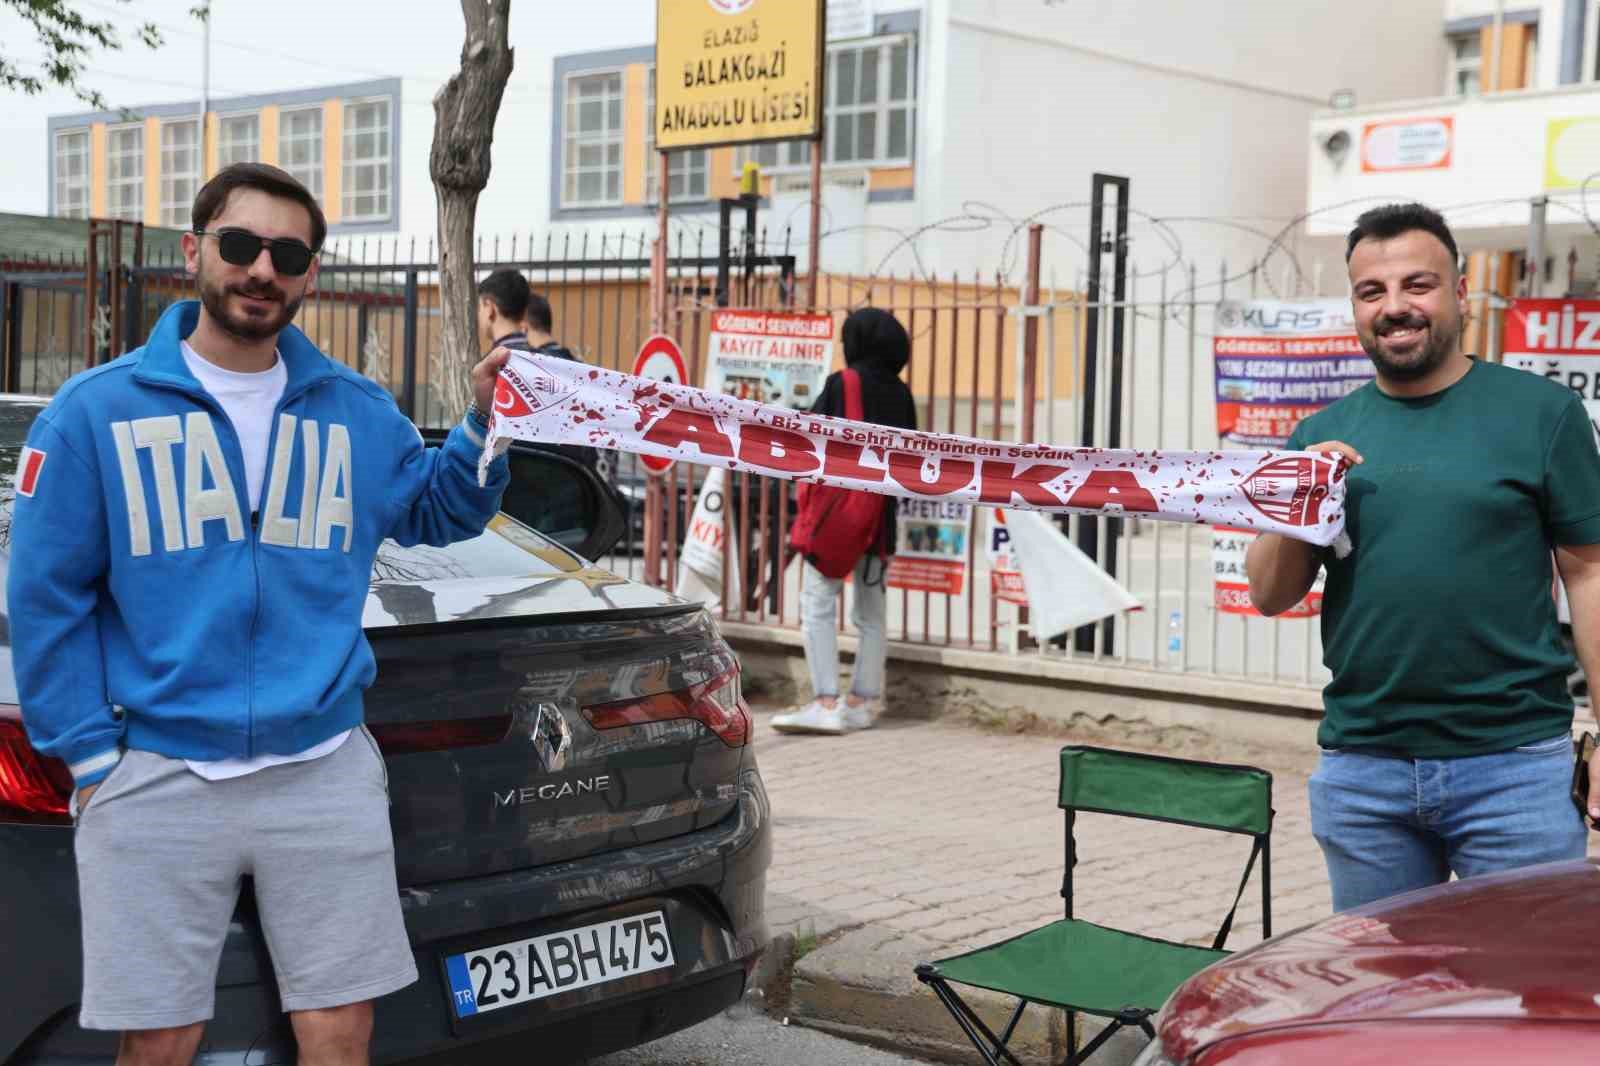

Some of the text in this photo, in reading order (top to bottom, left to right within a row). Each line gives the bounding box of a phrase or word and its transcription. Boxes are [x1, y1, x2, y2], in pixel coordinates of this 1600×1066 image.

[683, 40, 786, 88] BALAKGAZİ
[661, 81, 810, 132] ANADOLU LİSESİ
[719, 338, 825, 361] KAYIT ALINIR
[771, 415, 803, 431] Biz
[808, 421, 835, 438] Bu
[842, 427, 893, 448] Şehri
[642, 408, 1160, 513] ABLUKA
[110, 410, 355, 558] ITALIA
[494, 775, 610, 808] MEGANE
[455, 990, 474, 1005] TR
